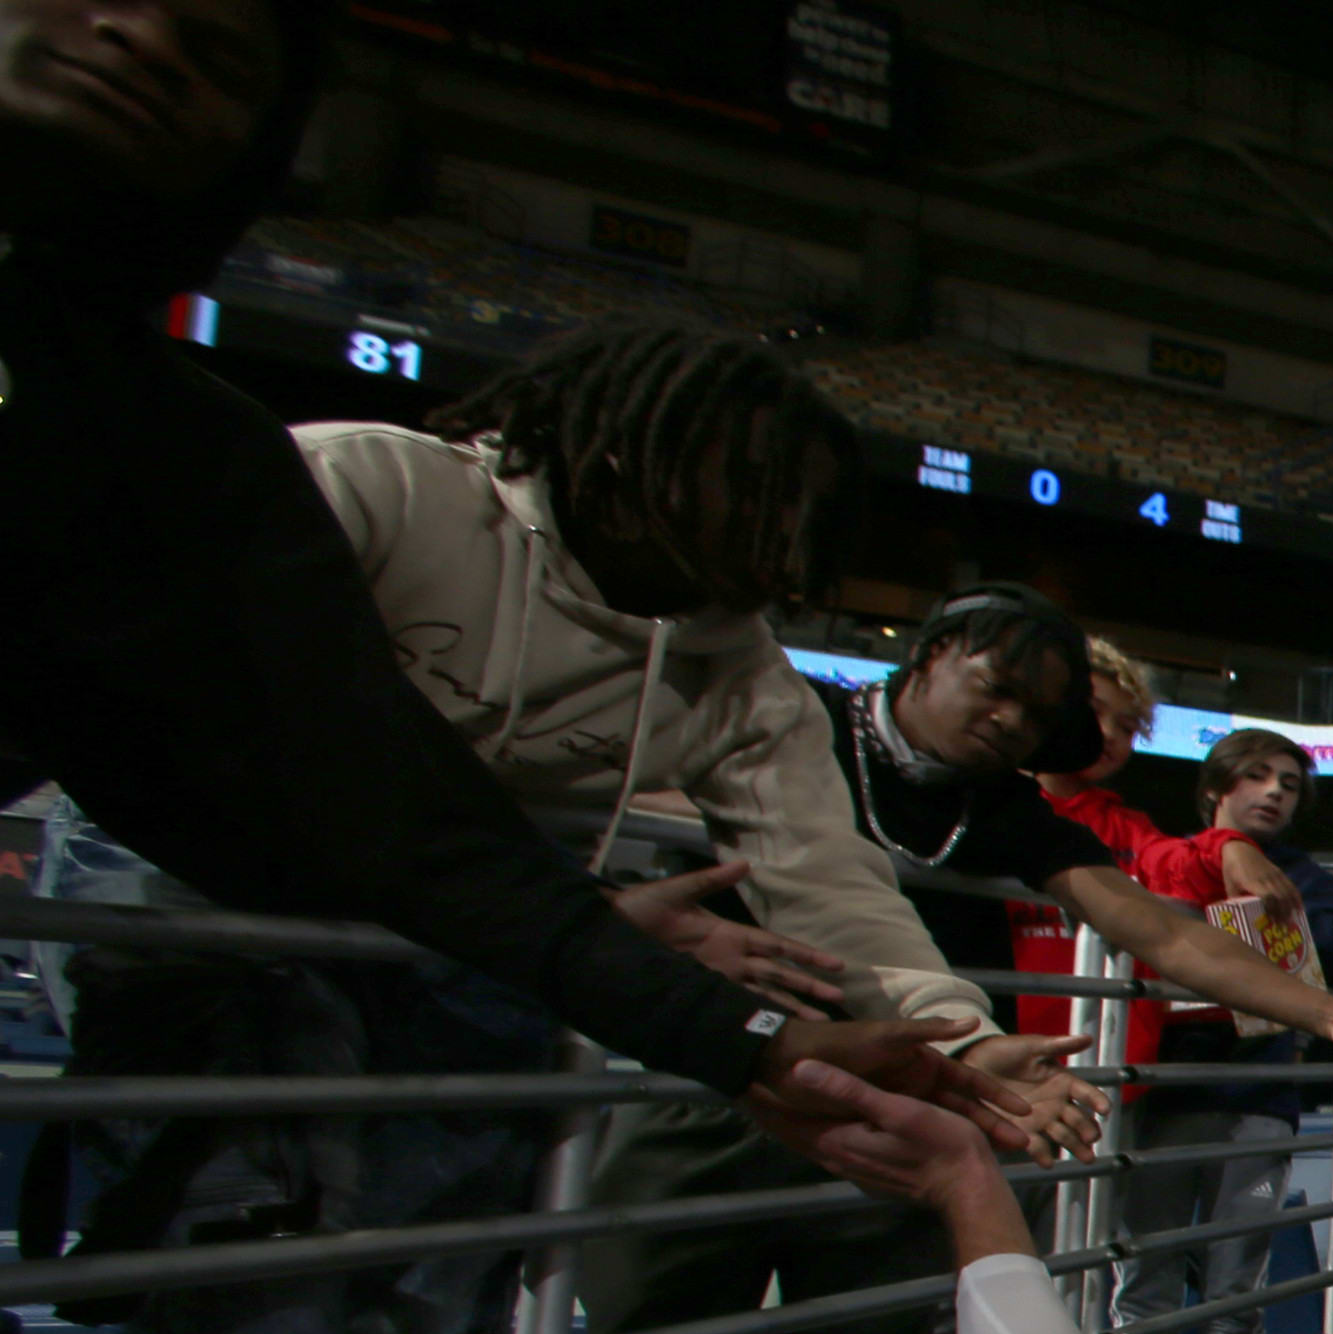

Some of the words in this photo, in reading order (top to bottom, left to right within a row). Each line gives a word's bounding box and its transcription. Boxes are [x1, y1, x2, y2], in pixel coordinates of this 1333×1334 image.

[348, 331, 422, 381] 81
[1030, 468, 1060, 505] 0
[1140, 492, 1169, 526] 4
